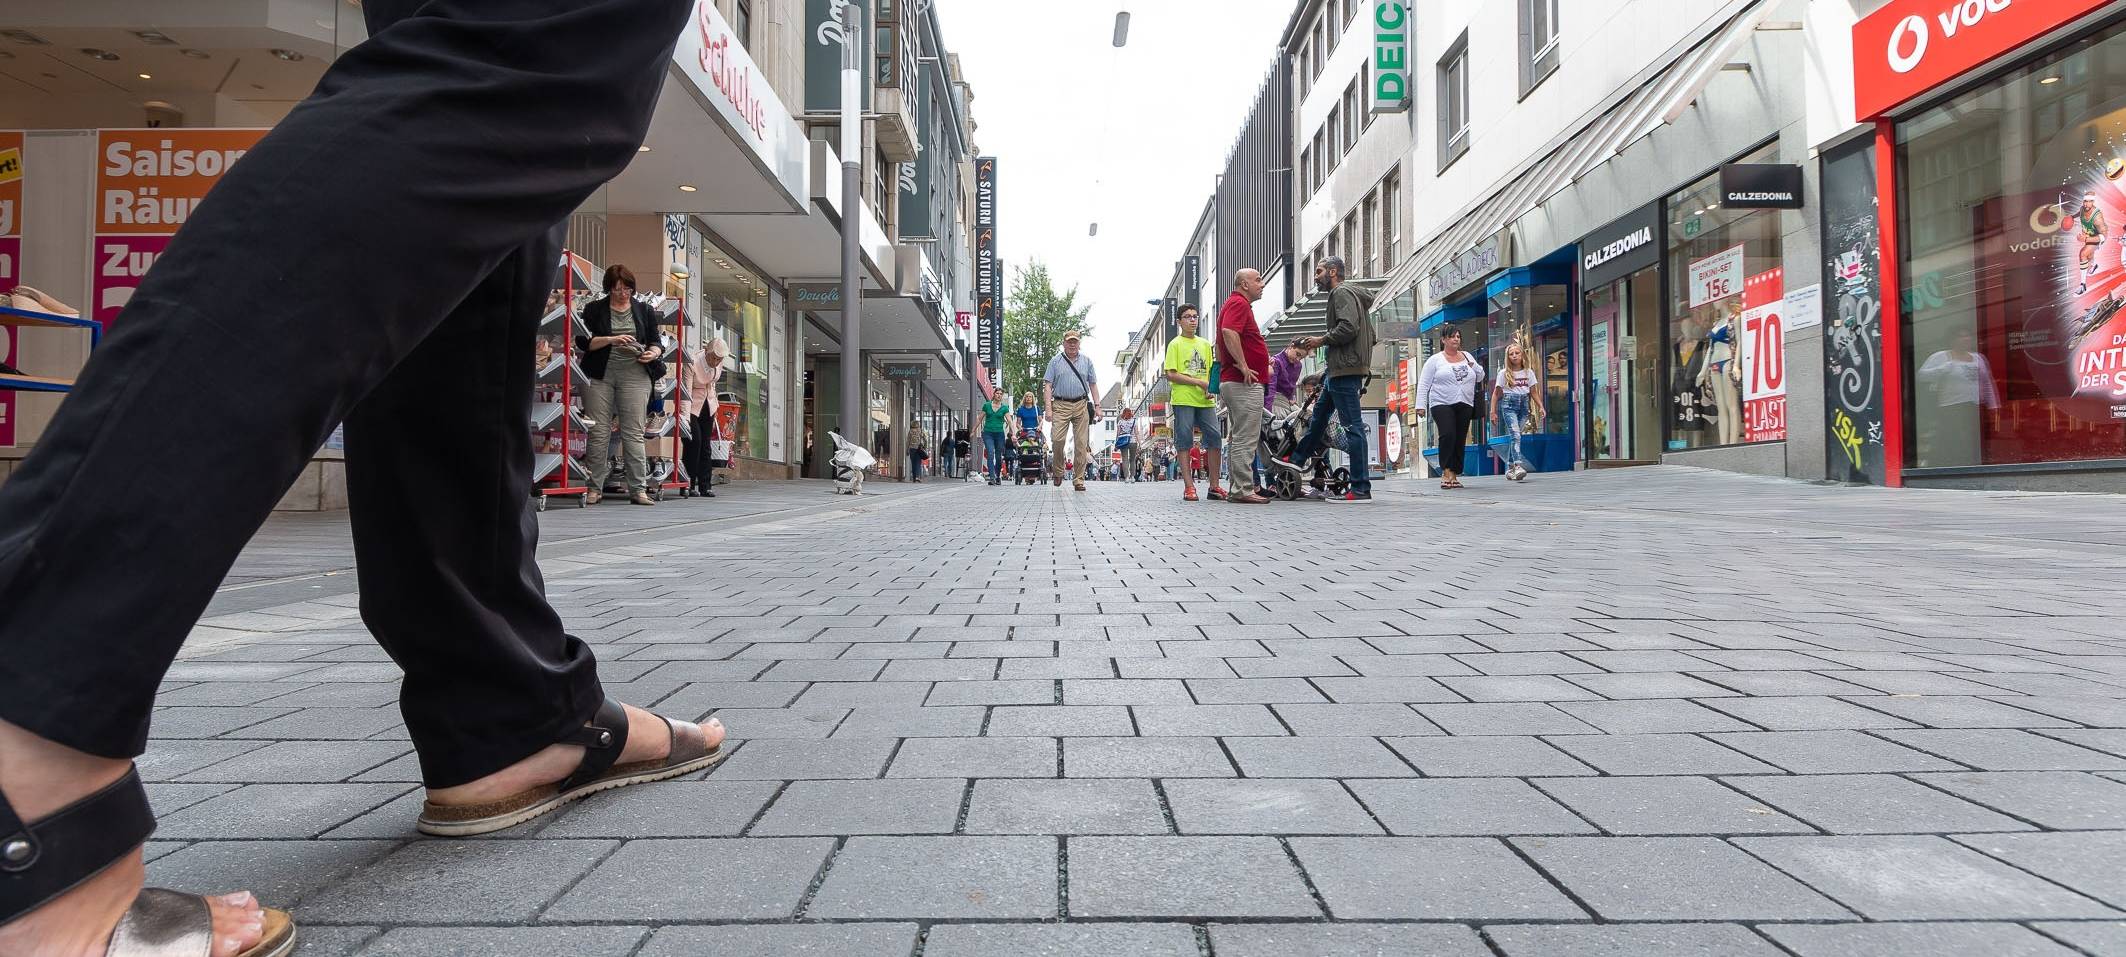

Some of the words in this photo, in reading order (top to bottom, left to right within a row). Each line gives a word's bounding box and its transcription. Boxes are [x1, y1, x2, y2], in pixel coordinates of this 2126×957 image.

[1376, 3, 1404, 100] DEIC
[698, 0, 766, 142] Schuhe
[104, 187, 201, 224] Räu
[980, 181, 991, 224] SATURN
[1728, 192, 1793, 201] CALZEDONIA
[102, 245, 164, 276] Zu
[1584, 226, 1652, 270] CALZEDONIA
[980, 249, 991, 293] SATURN
[1699, 262, 1732, 281] BIKINI-SET
[797, 288, 841, 304] Dougla
[1705, 279, 1730, 300] 15€
[979, 318, 991, 362] SATURN
[2081, 373, 2109, 388] DER
[1752, 398, 1786, 431] LAST
